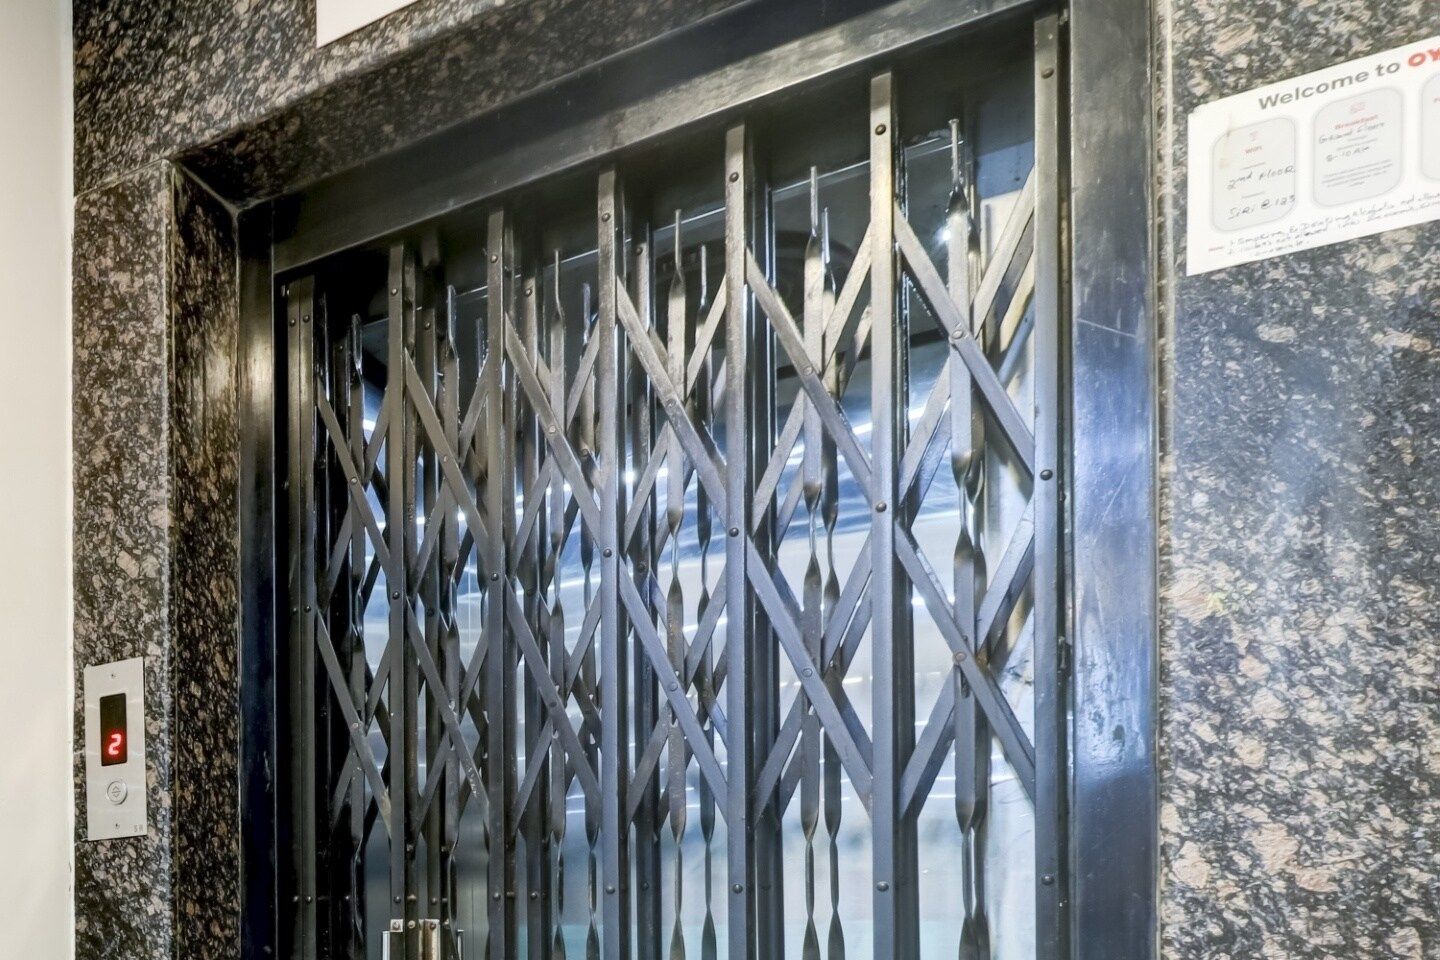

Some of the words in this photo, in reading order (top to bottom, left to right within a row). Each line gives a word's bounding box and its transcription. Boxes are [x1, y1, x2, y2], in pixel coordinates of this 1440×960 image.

[1258, 71, 1370, 110] Welcome
[1375, 63, 1401, 77] to
[107, 733, 122, 755] 2
